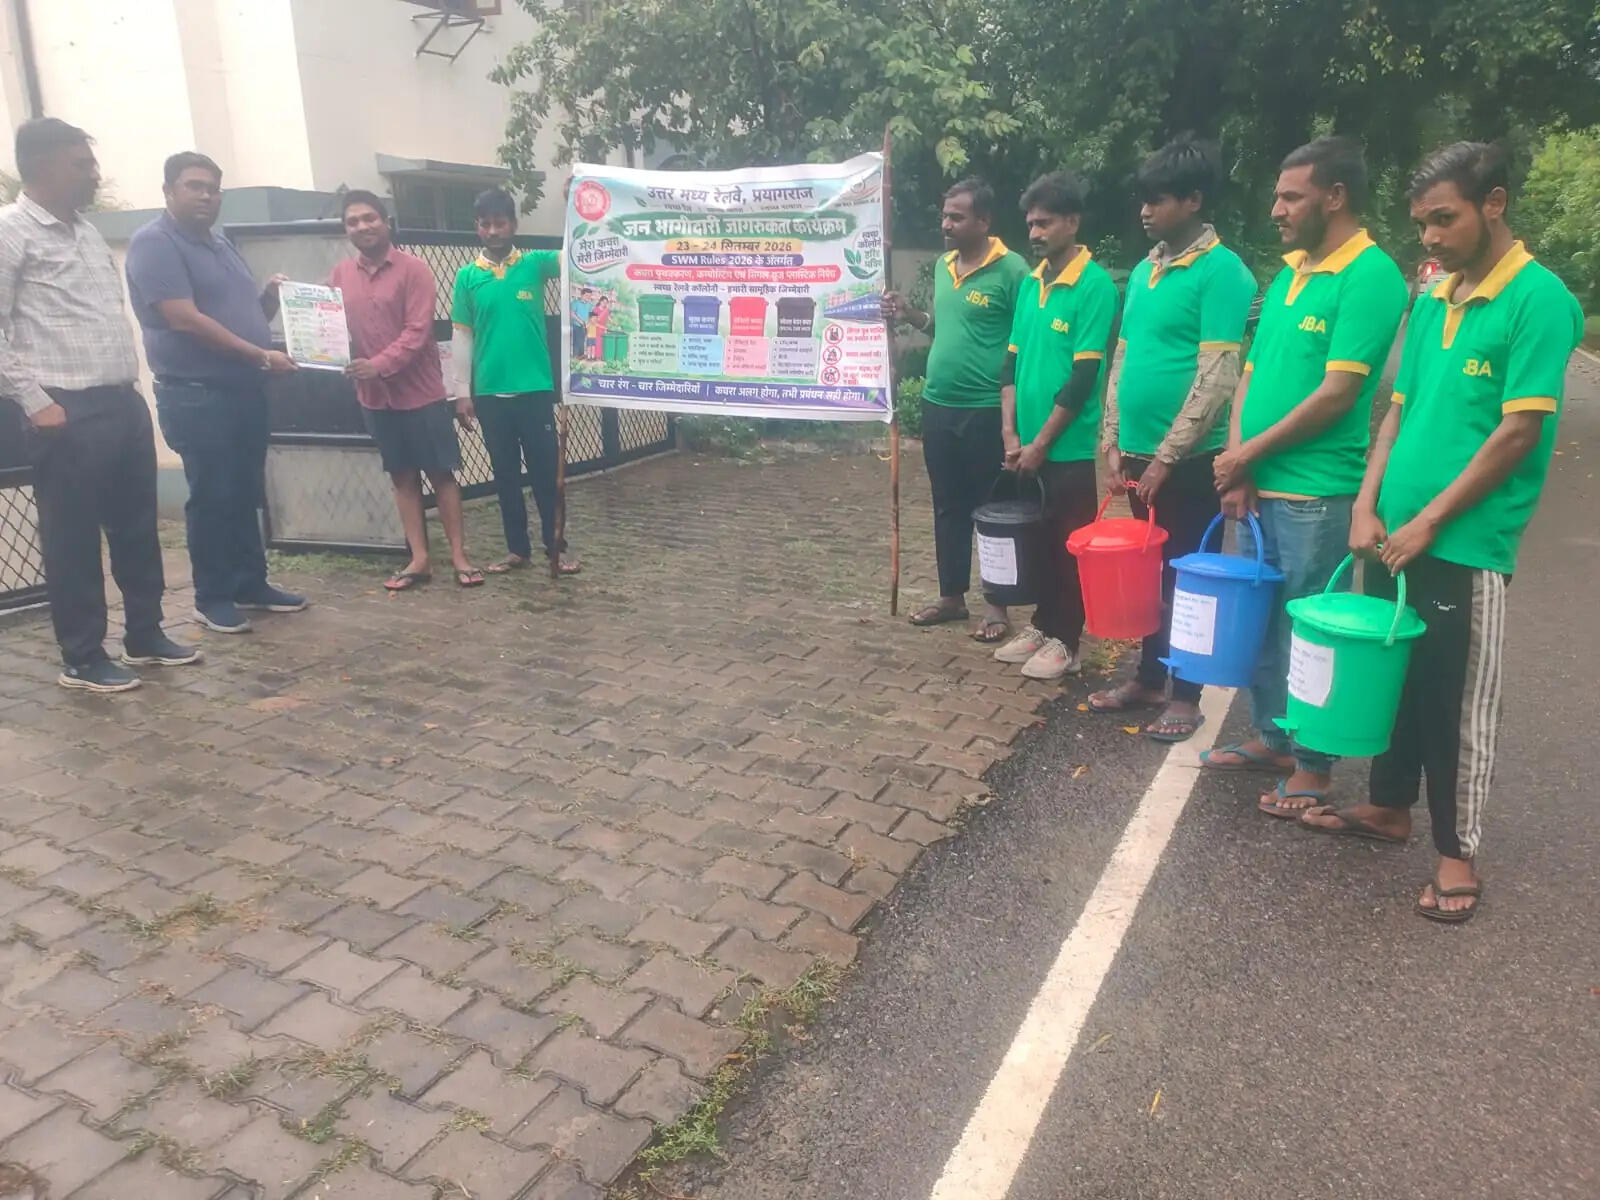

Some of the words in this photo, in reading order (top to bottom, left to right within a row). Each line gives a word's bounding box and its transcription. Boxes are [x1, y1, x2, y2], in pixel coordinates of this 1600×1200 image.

[647, 186, 674, 200] उत्तर
[680, 188, 710, 202] मध्य
[752, 187, 814, 202] प्रयागराज
[622, 220, 651, 236] जन
[655, 215, 720, 235] भागीदारी
[579, 239, 595, 251] मेरा
[597, 236, 620, 248] कचरा
[676, 241, 690, 251] 23
[701, 241, 718, 251] 24
[765, 241, 792, 251] 2026
[577, 252, 592, 264] मेरी
[593, 245, 628, 262] जिम्मेदारी
[671, 256, 698, 265] SWM
[700, 256, 726, 265] Rules
[728, 256, 753, 266] 2026
[754, 255, 765, 266] के
[674, 283, 689, 292] रेलवे
[727, 284, 747, 293] हमारी
[777, 284, 810, 294] जिम्मेदारी
[965, 290, 989, 308] JBA
[1051, 317, 1069, 335] JBA
[1298, 315, 1326, 334] JBA
[598, 379, 615, 389] चार
[617, 378, 629, 390] रंग
[638, 381, 653, 392] चार
[715, 385, 736, 396] कचरा
[738, 387, 758, 398] अलग
[760, 385, 780, 399] होगा,
[782, 387, 797, 399] तभी
[825, 388, 842, 401] सही
